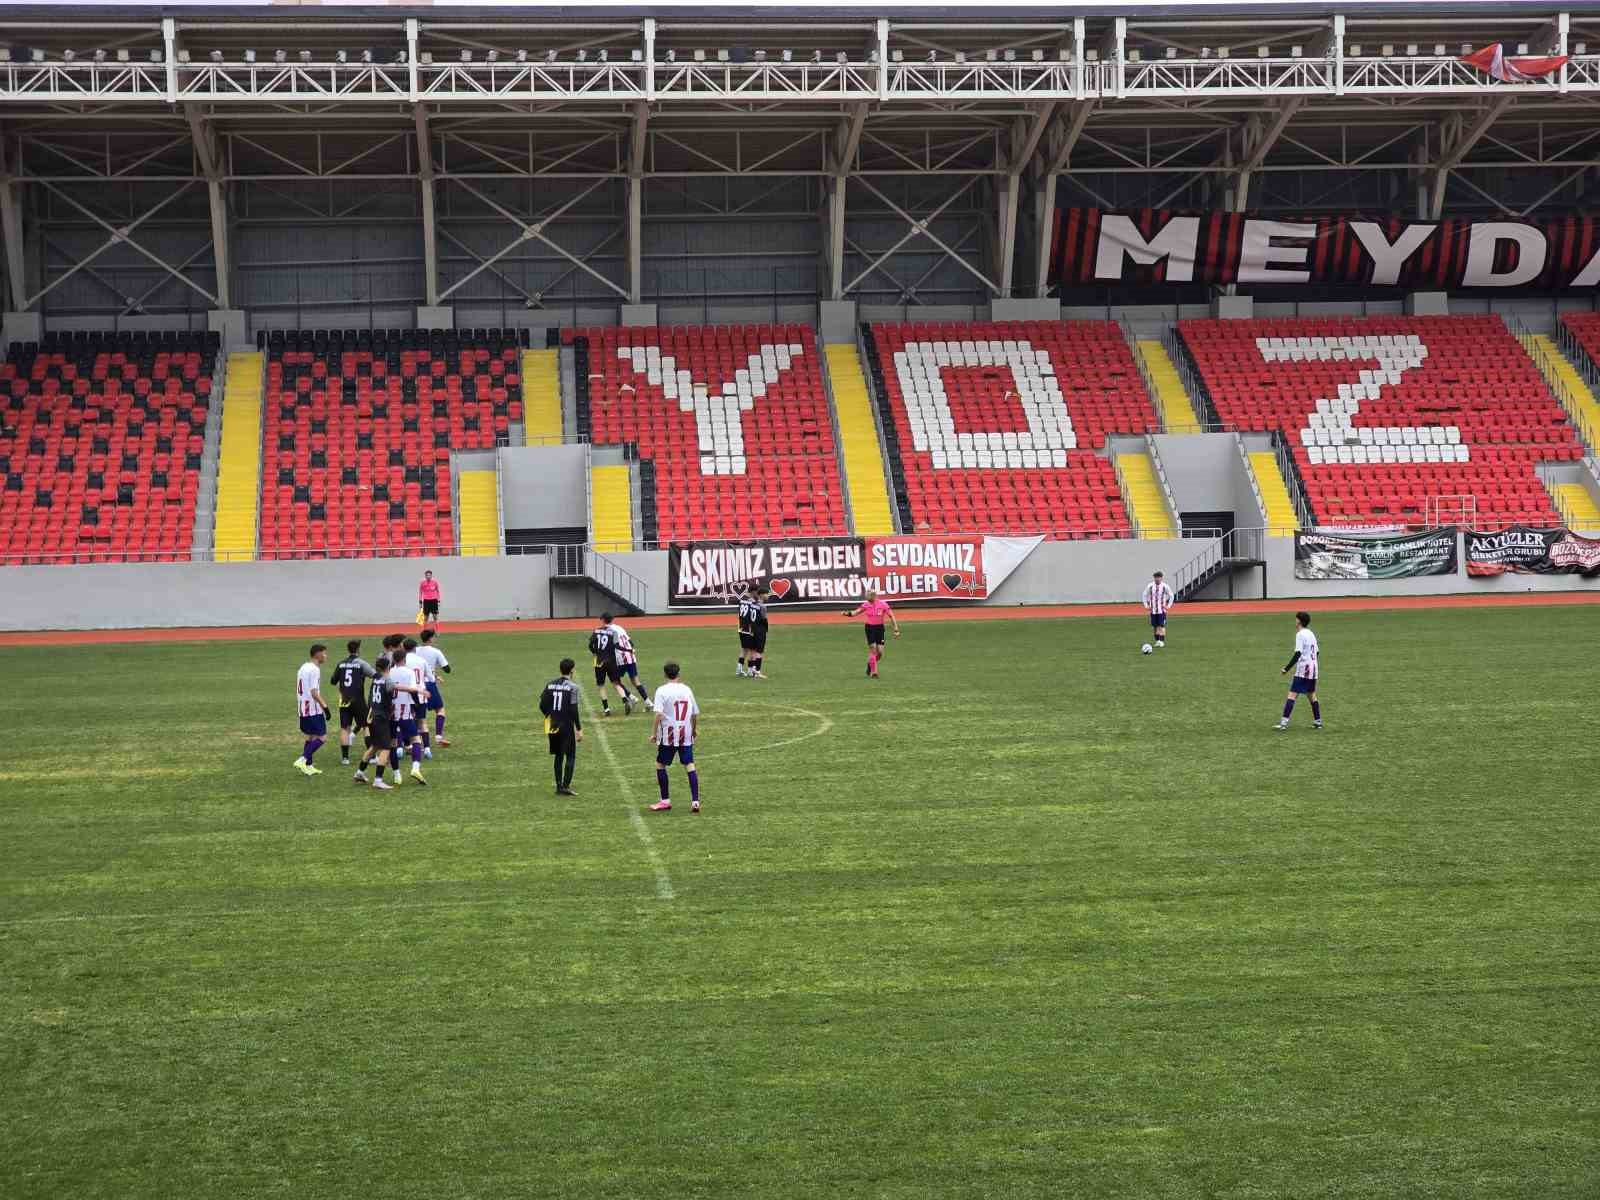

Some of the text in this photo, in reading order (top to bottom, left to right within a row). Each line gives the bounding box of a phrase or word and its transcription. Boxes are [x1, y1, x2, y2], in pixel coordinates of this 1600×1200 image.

[1470, 531, 1546, 551] AKYÜZLER
[1514, 548, 1546, 556] GRUBU
[677, 543, 976, 596] AŞKIMIZ EZELDEN SEVDAMIZ
[795, 572, 939, 598] YERKÖYLÜLER
[596, 634, 609, 651] 19
[343, 669, 353, 687] 5
[673, 701, 689, 721] 17
